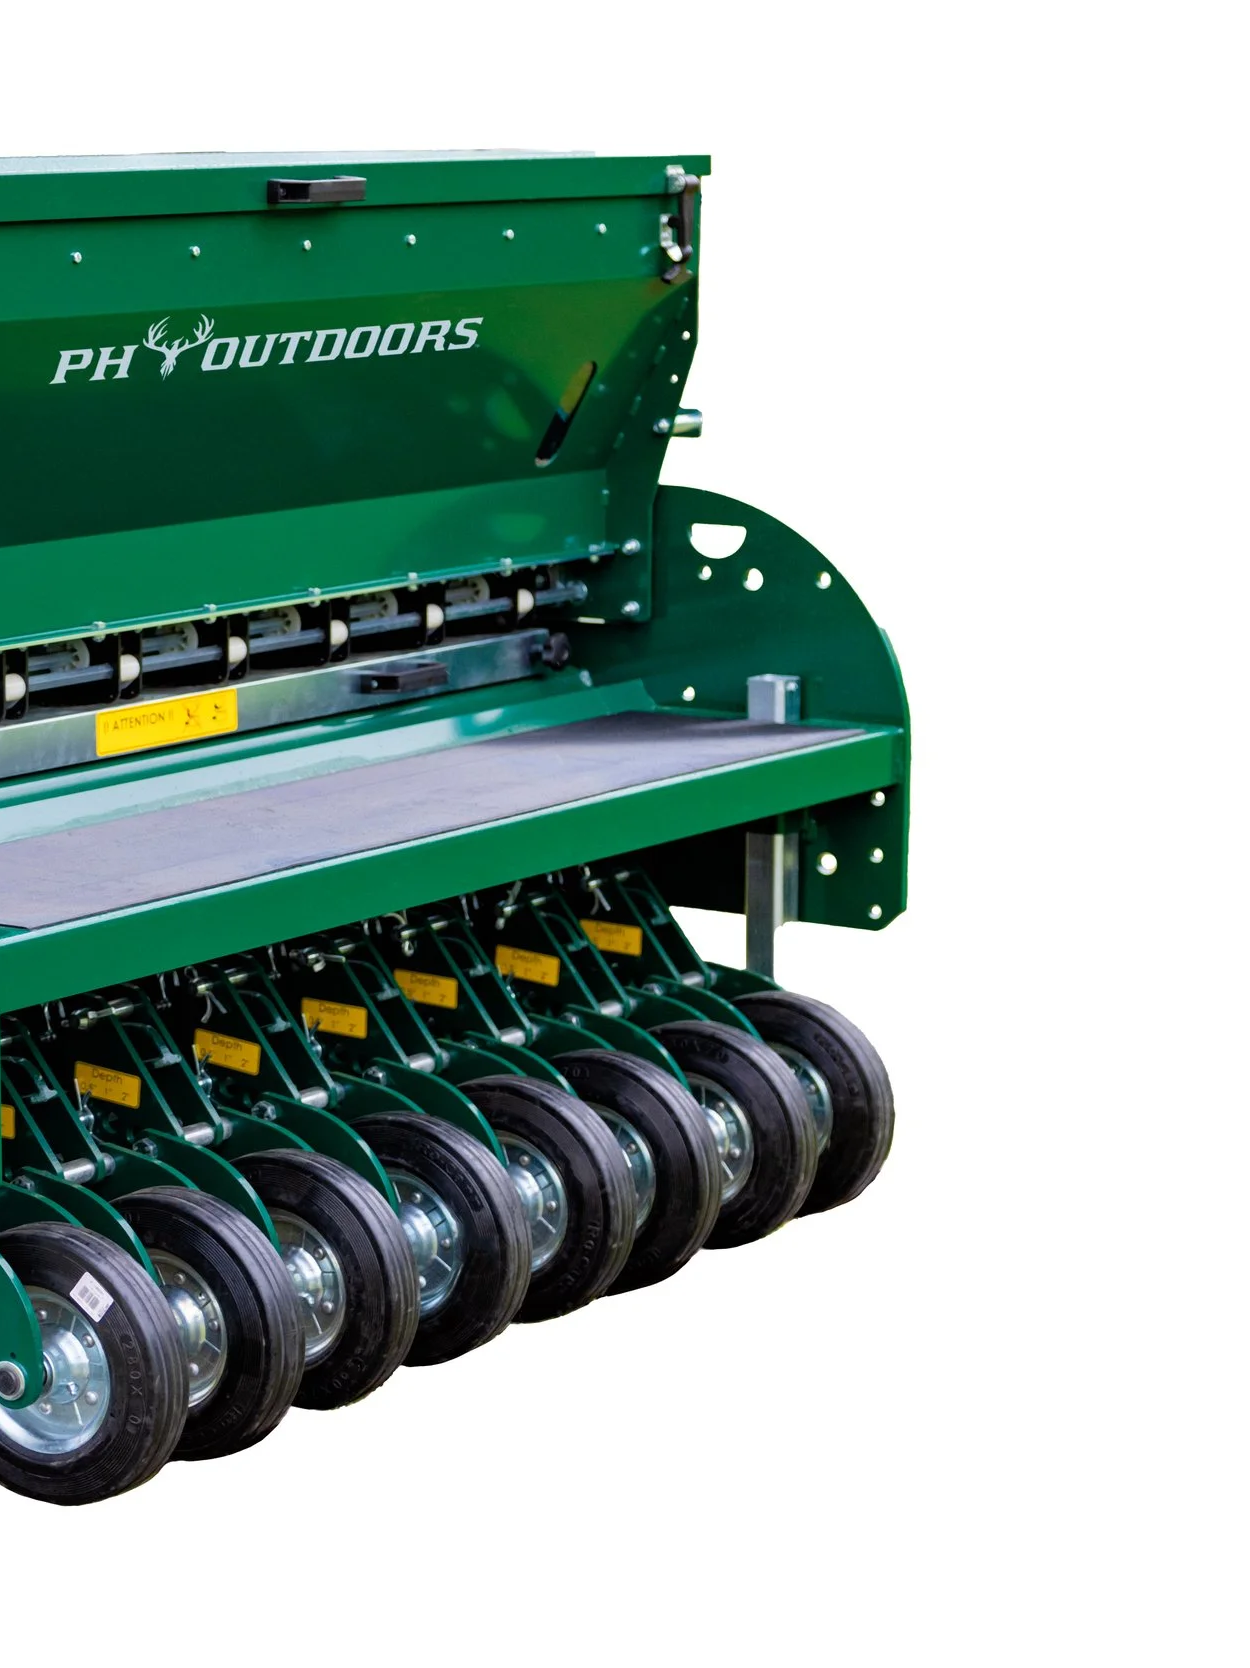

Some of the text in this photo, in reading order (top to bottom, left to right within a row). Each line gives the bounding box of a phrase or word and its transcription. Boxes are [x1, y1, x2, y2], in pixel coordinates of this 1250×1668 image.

[49, 317, 484, 385] PH OUTDOORS
[113, 712, 165, 729] ATTENTION
[211, 1034, 243, 1051] Depth
[91, 1067, 123, 1084] Depth
